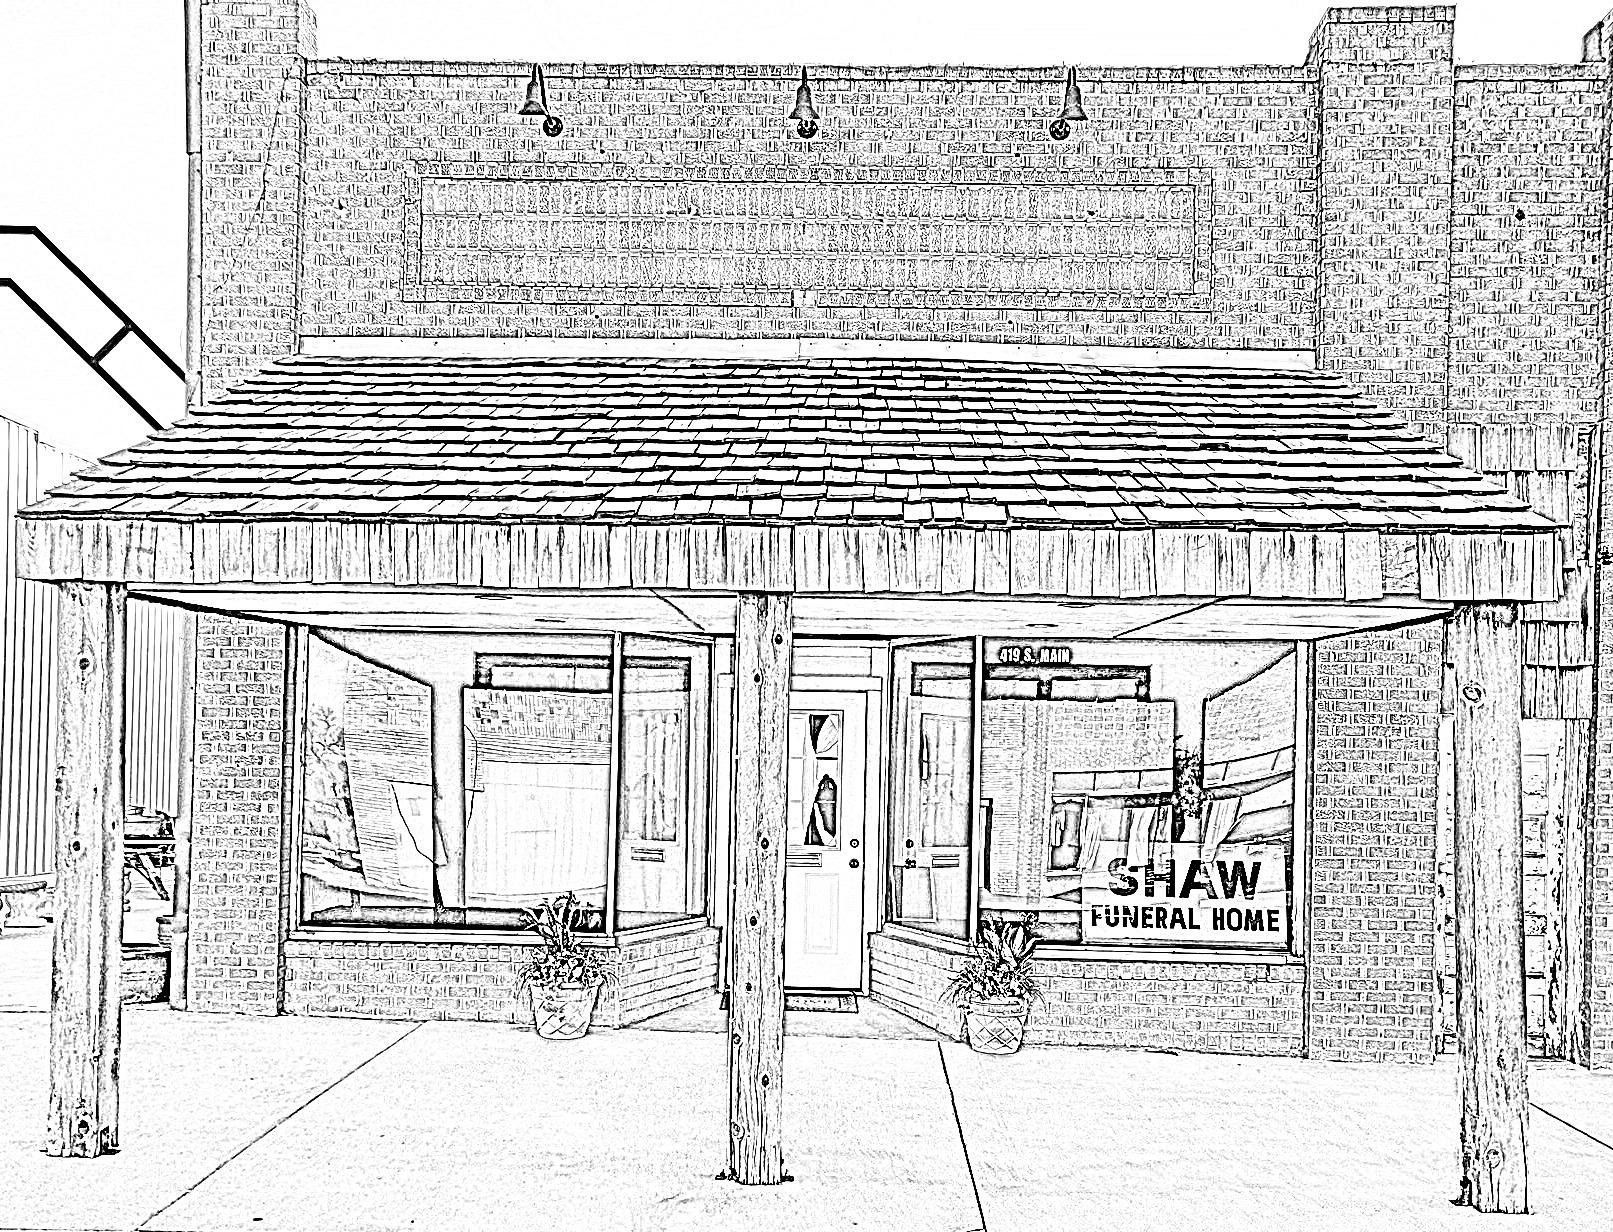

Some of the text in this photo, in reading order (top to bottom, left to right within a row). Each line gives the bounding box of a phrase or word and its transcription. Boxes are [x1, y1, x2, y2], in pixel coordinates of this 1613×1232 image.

[1000, 647, 1070, 663] 419 S. MAIN
[1107, 857, 1262, 900] SHAW
[1091, 904, 1280, 932] FUNERAL HOME
